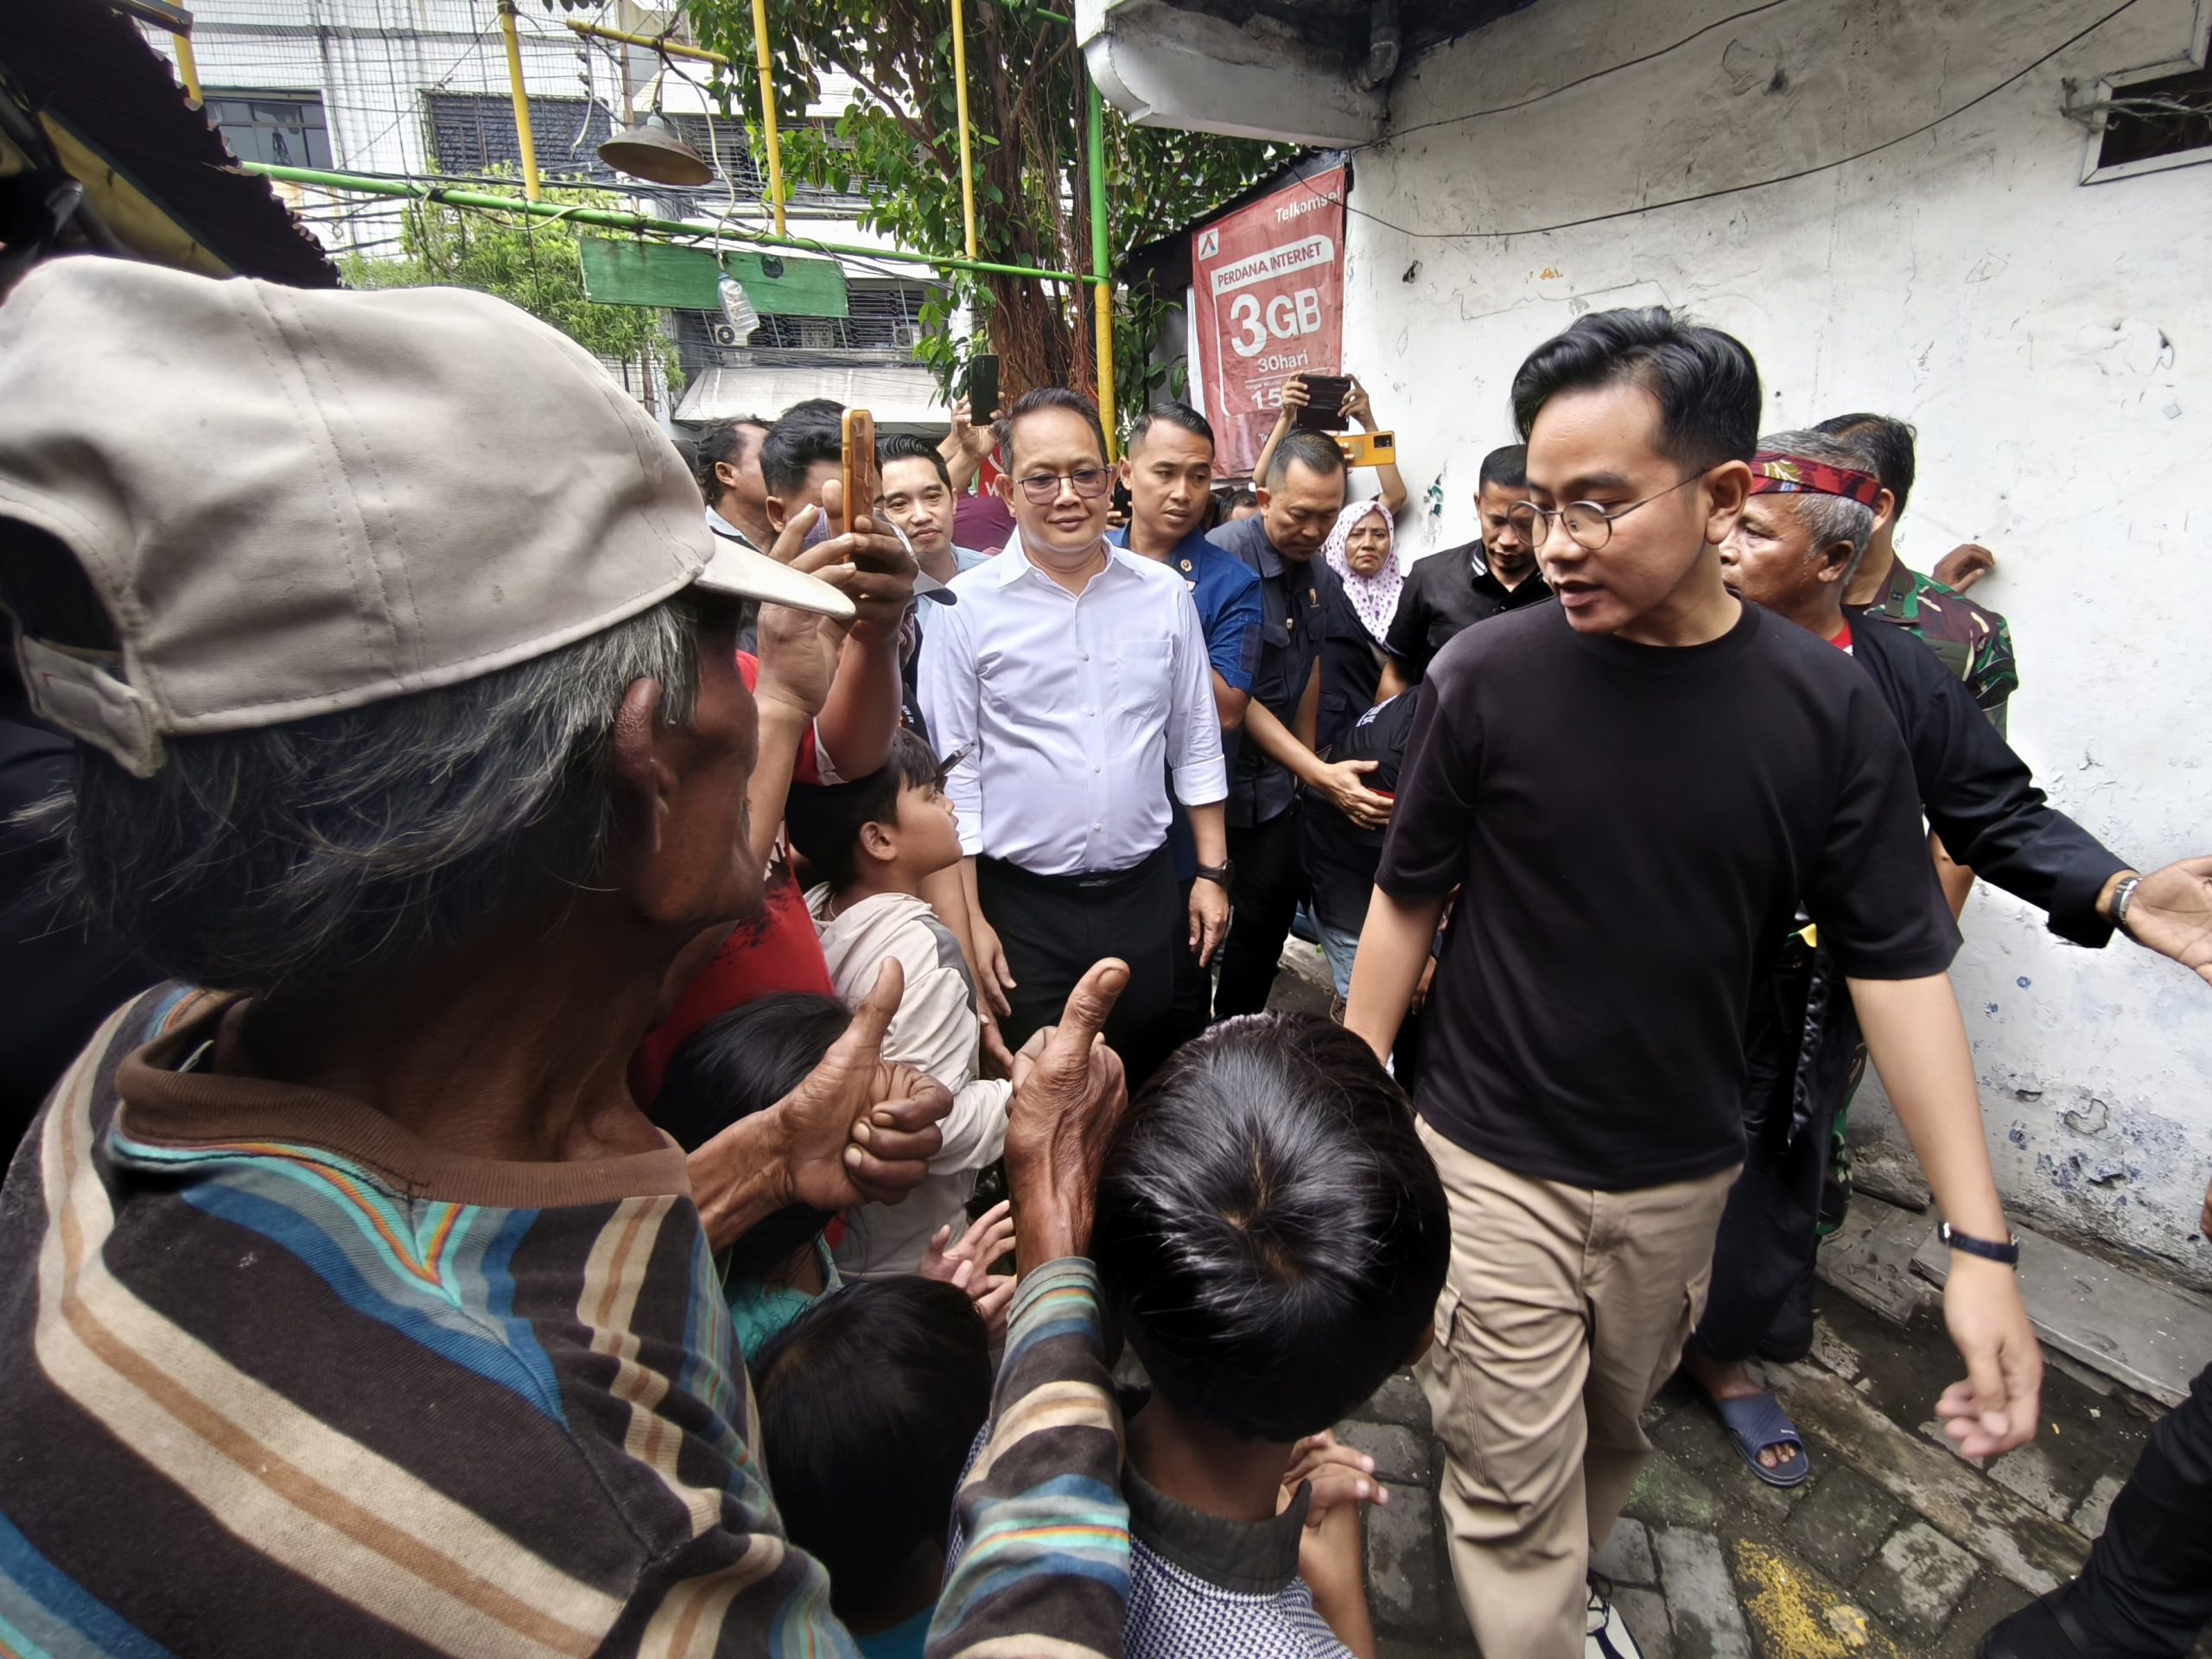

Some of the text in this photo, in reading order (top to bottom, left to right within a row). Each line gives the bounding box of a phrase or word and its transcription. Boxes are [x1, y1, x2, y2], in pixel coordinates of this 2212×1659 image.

[1275, 185, 1340, 222] Telkomsel
[1217, 242, 1321, 288] PERDANA INTERNET
[1230, 288, 1321, 357] 3GB
